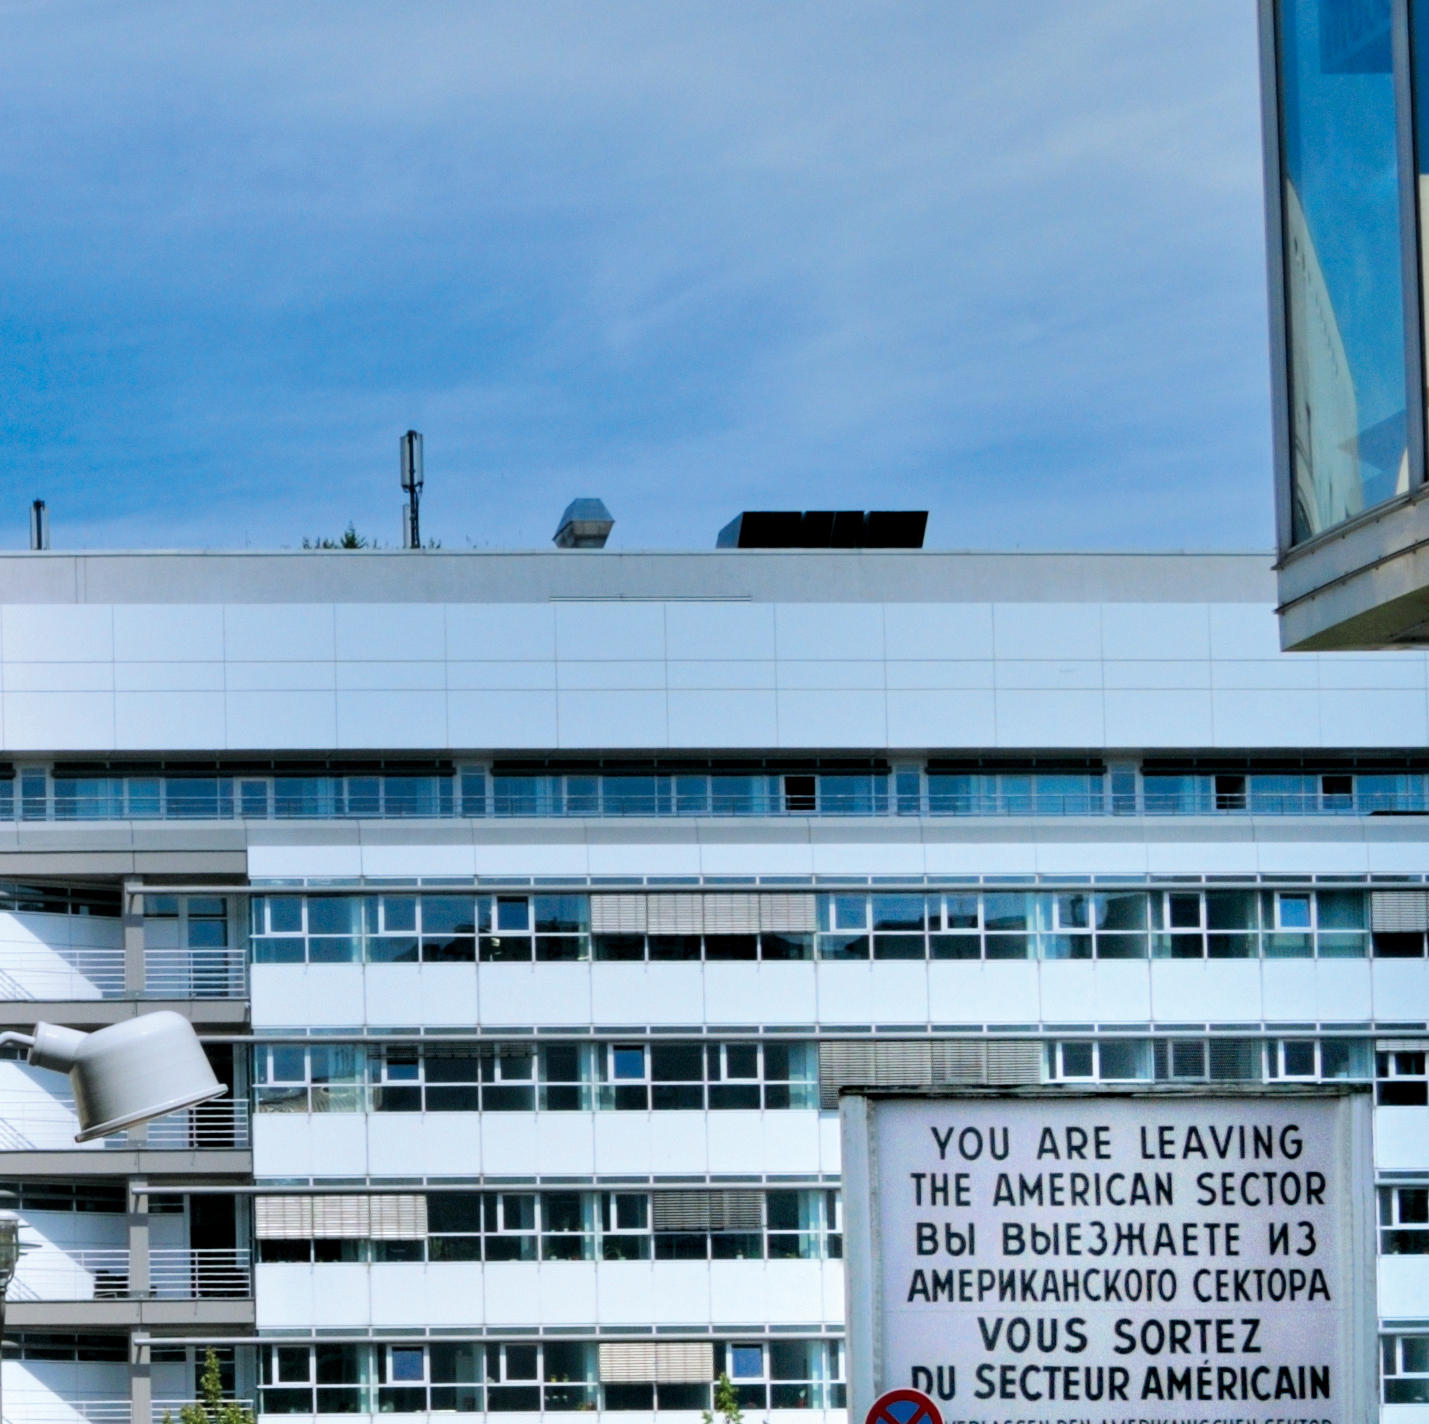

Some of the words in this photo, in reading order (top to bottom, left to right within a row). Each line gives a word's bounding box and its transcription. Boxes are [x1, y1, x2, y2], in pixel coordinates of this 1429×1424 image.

[931, 1126, 1009, 1161] YOU
[1037, 1126, 1111, 1160] ARE
[1141, 1124, 1303, 1160] LEAVING
[911, 1172, 971, 1207] THE
[993, 1172, 1174, 1207] AMERICAN
[1197, 1171, 1326, 1207] SECTOR
[916, 1222, 975, 1257] ВЫ
[1002, 1221, 1240, 1257] ВЫЕЗЖАЕТЕ
[1269, 1221, 1317, 1257] ИЗ
[908, 1267, 1177, 1303] АМЕРИКАНСКОГО
[1193, 1267, 1331, 1303] СЕКТОРА
[978, 1316, 1088, 1354] VOUS
[1114, 1318, 1261, 1356] SORTEZ
[912, 1366, 956, 1400] DU
[974, 1363, 1130, 1401] SECTEUR
[1141, 1357, 1331, 1401] AMÉRICAIN
